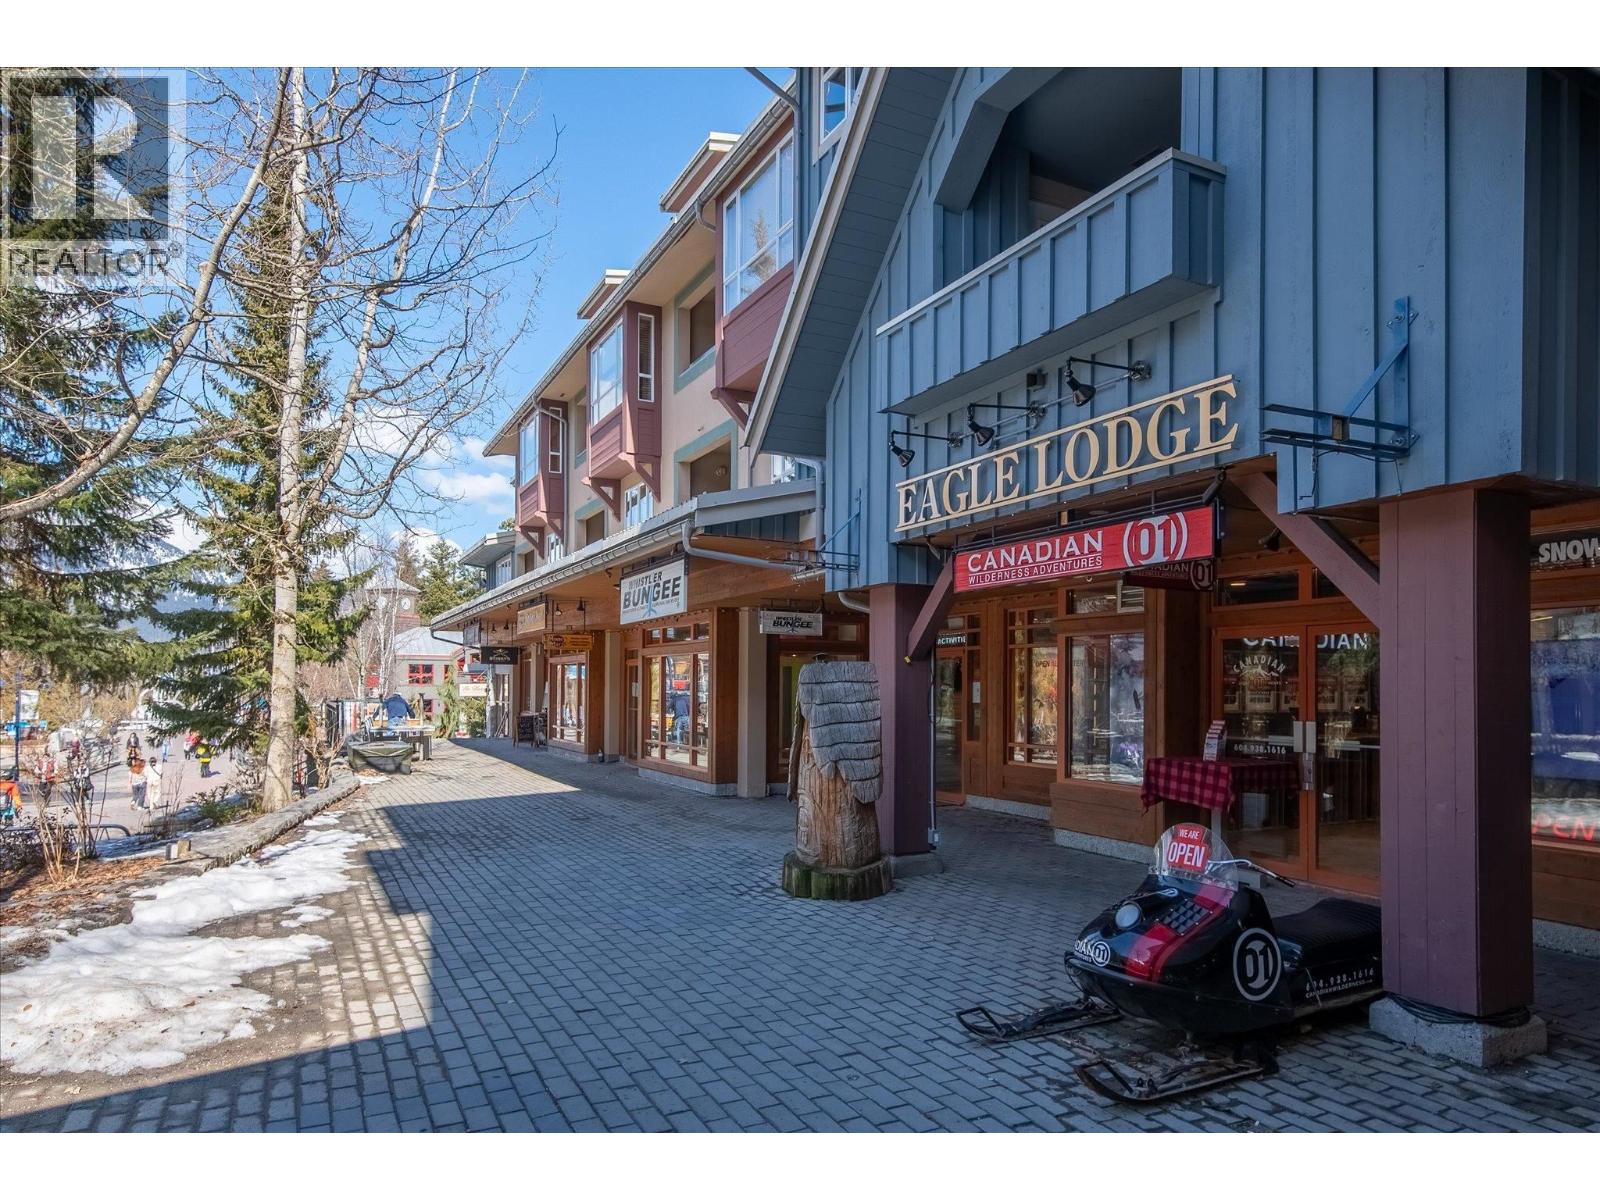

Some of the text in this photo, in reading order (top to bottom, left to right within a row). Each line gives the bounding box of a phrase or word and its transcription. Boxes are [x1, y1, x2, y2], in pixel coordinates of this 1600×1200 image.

[896, 382, 1239, 528] EAGLE LODGE
[968, 530, 1103, 573] CANADIAN
[968, 556, 1103, 585] WILDERNESS ADVENTURES
[623, 576, 682, 610] BUNGEE
[772, 620, 813, 629] BUNGEE
[1233, 655, 1287, 673] CANADIAN
[1179, 829, 1200, 840] WE ARE
[1168, 842, 1206, 869] OPEN
